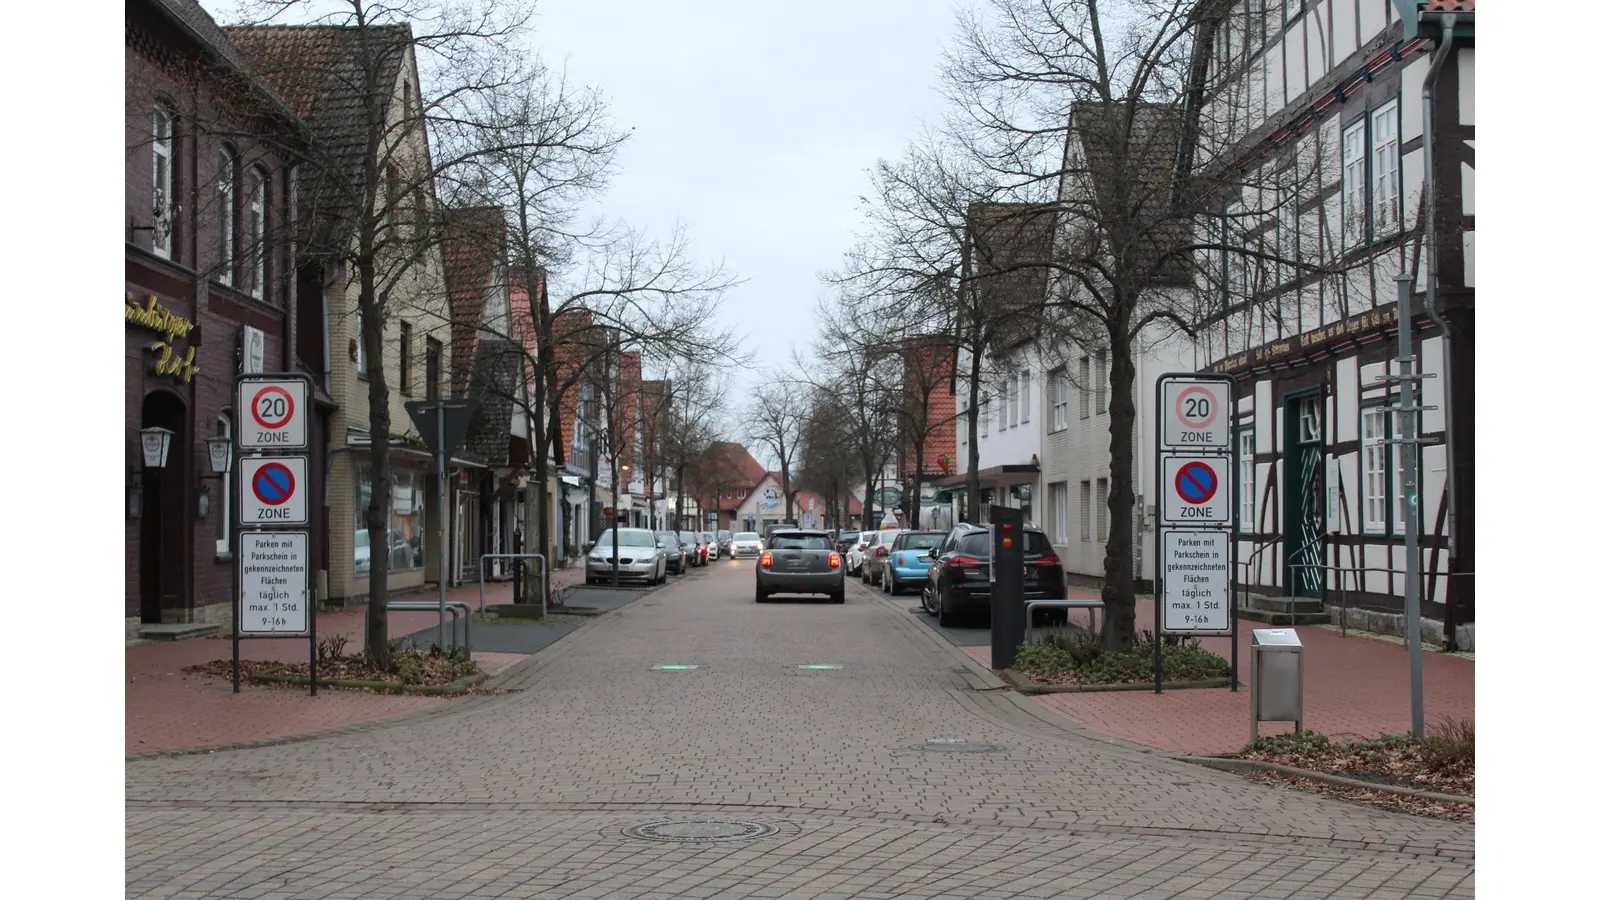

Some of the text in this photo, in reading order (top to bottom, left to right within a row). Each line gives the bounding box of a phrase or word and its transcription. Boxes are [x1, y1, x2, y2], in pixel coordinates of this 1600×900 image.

[261, 398, 285, 418] 20
[1185, 398, 1209, 417] 20
[257, 432, 289, 443] ZONE
[1180, 432, 1213, 442] ZONE
[258, 508, 290, 519] ZONE
[1180, 507, 1213, 517] ZONE
[255, 540, 293, 548] Parken mit
[1178, 538, 1215, 546] Parken mit
[251, 552, 297, 560] Parkschein in
[1174, 550, 1219, 559] Parkschein in
[244, 564, 304, 574] gekennzeichneten
[1167, 563, 1226, 572] gekennzeichneten
[261, 576, 287, 585] Flächen
[1183, 575, 1209, 583] Flächen
[259, 590, 290, 600] täglich
[1182, 588, 1211, 599] täglich
[274, 603, 278, 611] 1
[282, 603, 299, 611] Std.
[1196, 601, 1200, 609] 1
[1204, 601, 1221, 609] Std.
